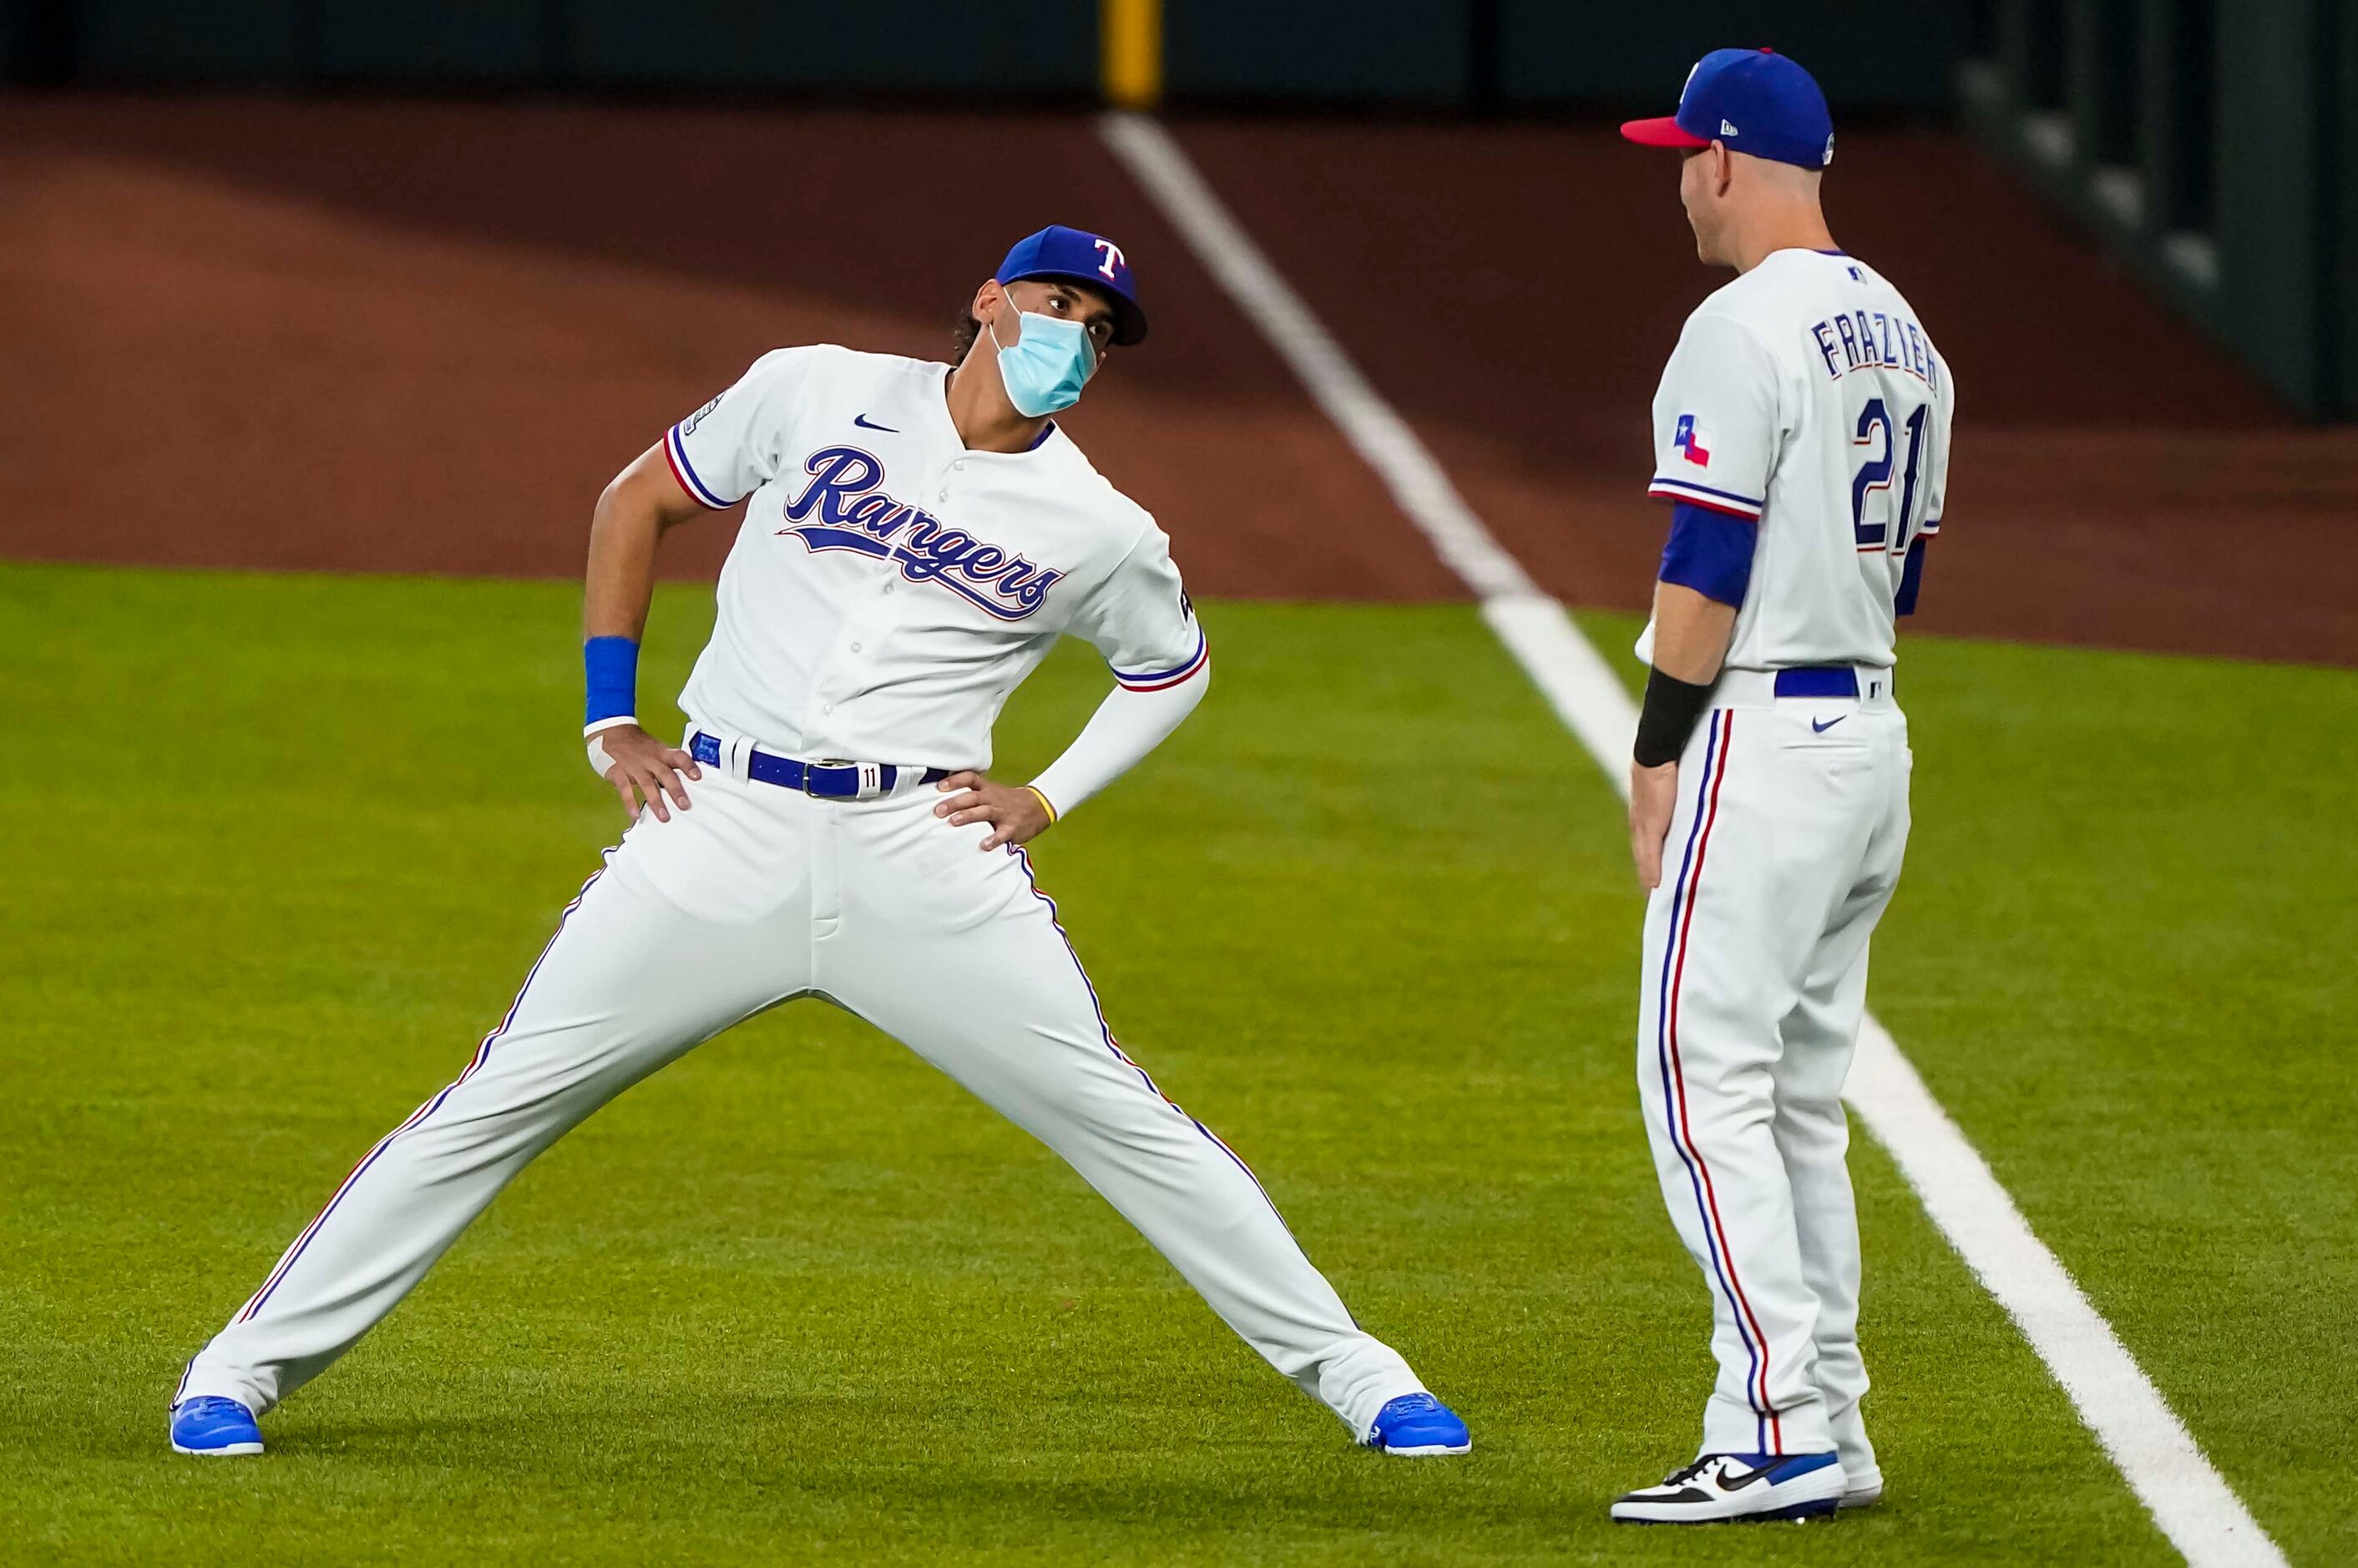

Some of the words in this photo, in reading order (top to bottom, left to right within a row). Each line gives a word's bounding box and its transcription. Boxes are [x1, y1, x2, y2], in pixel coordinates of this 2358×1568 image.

[1094, 238, 1126, 281] T
[1811, 310, 1937, 397] FRAZIER
[1851, 397, 1930, 556] 21
[775, 444, 1067, 621] Rangers
[864, 767, 875, 787] 11
